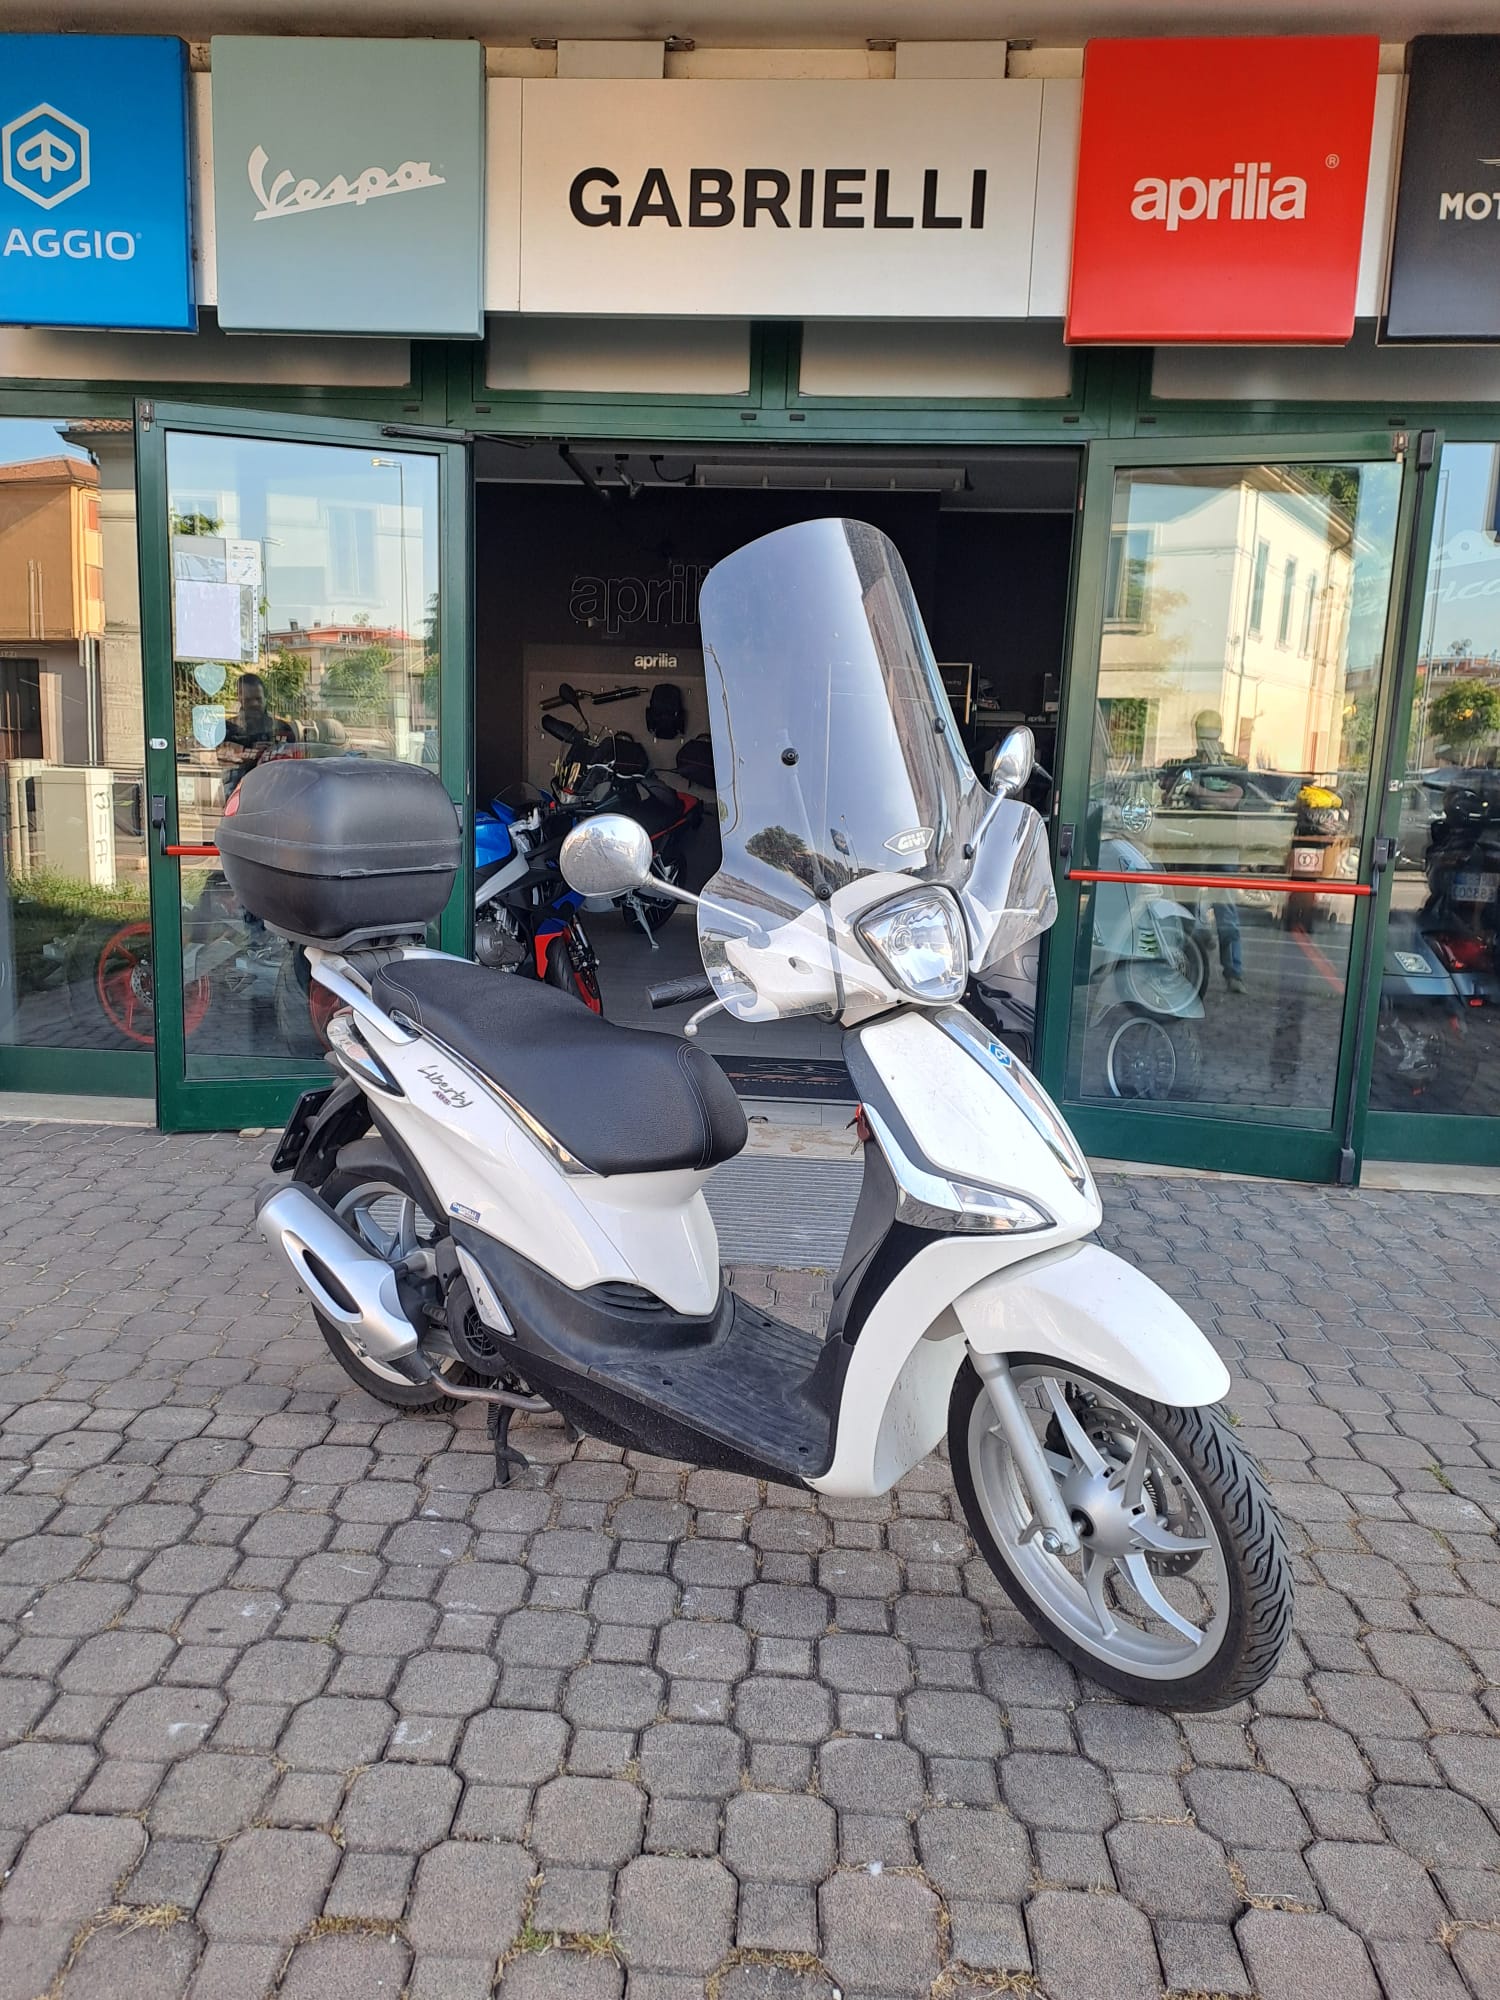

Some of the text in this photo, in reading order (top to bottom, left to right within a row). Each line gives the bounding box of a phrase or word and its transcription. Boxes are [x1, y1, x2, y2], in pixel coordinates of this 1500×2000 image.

[248, 144, 447, 221] Vespa
[569, 166, 988, 229] GABRIELLI
[1130, 162, 1307, 231] aprilia
[3, 228, 136, 261] AGGIO
[569, 564, 711, 634] april
[634, 653, 678, 670] aprilia
[898, 830, 926, 850] GIVI
[417, 1065, 473, 1108] Liberty
